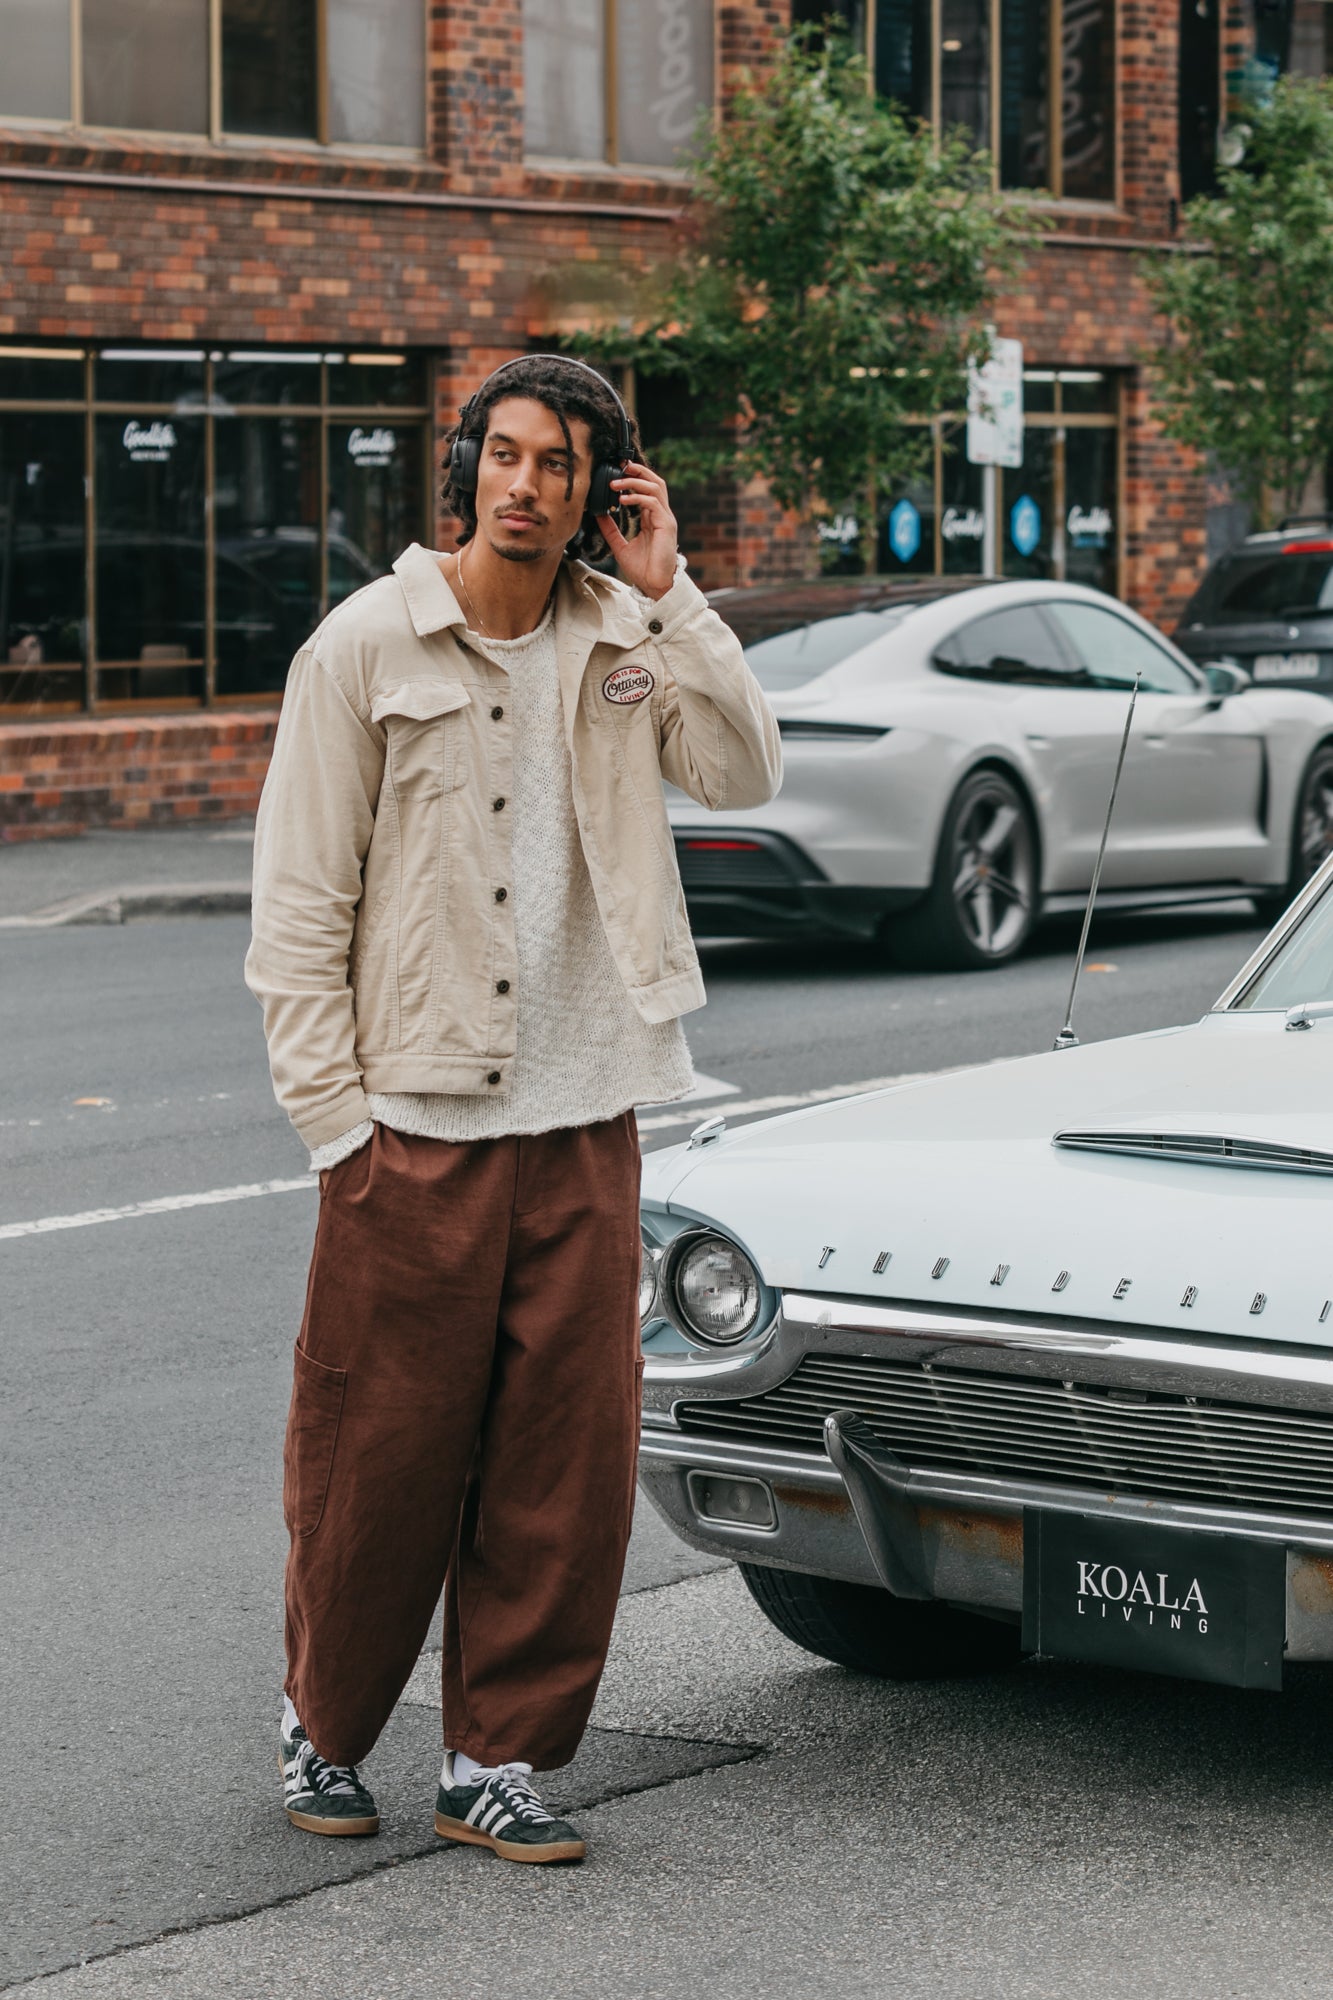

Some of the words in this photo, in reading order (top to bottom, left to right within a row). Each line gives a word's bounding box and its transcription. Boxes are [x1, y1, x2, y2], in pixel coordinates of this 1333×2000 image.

[607, 675, 650, 697] Ottway
[609, 673, 621, 683] LIFE
[619, 690, 645, 701] LIVING
[1077, 1561, 1209, 1614] KOALA
[1078, 1600, 1208, 1634] LIVING
